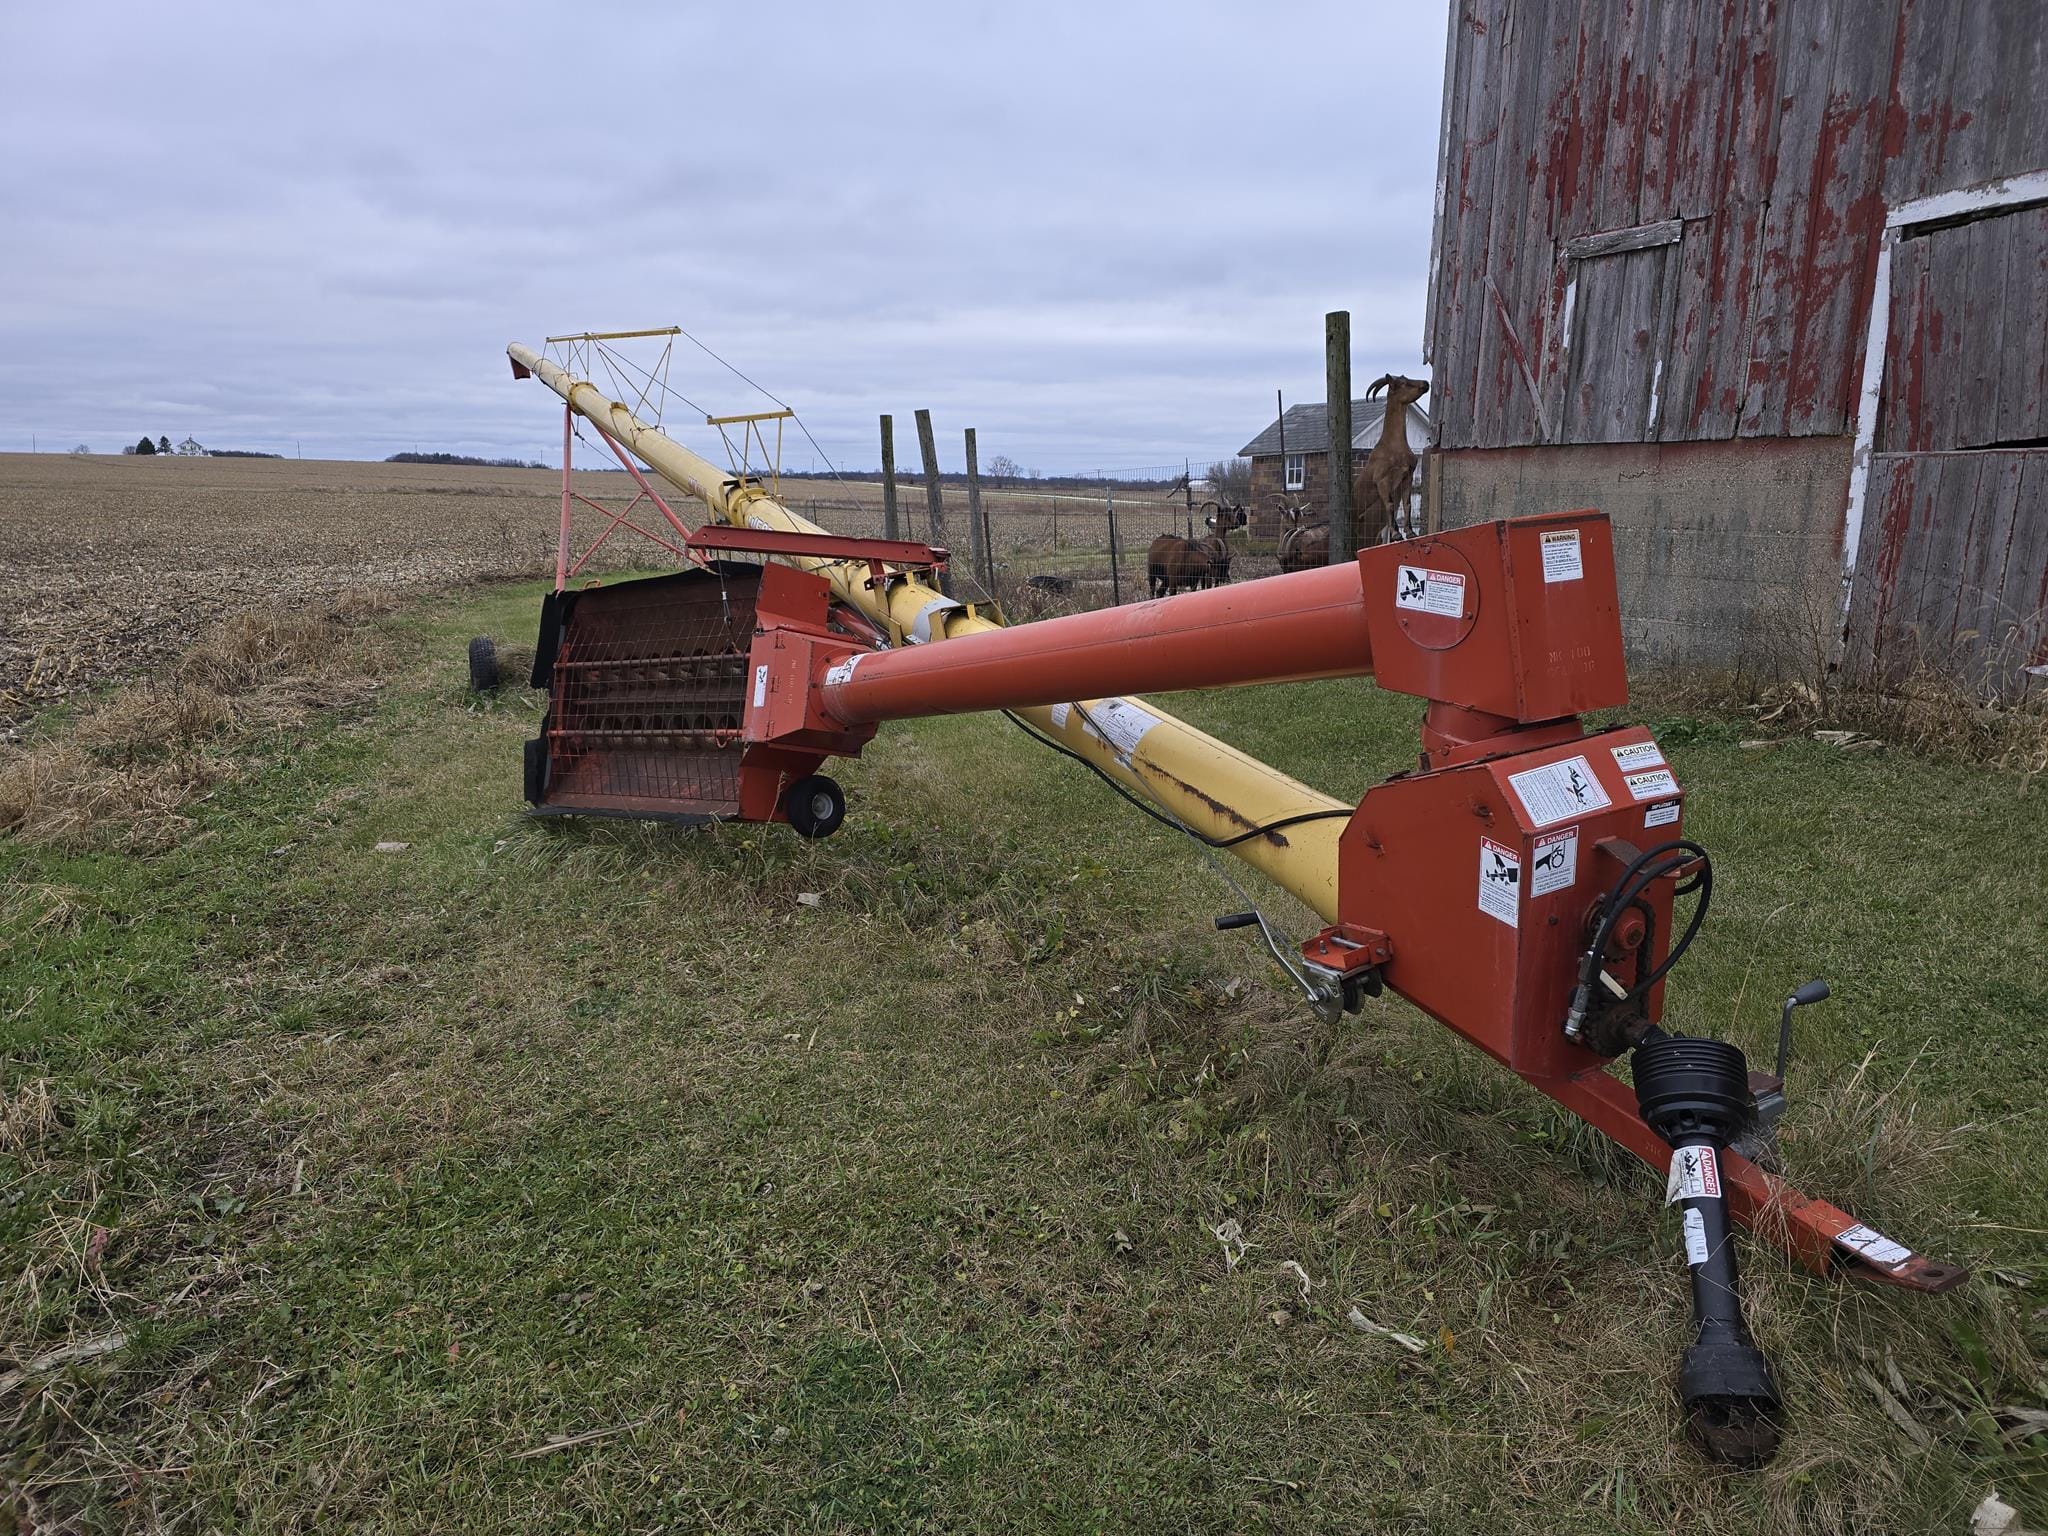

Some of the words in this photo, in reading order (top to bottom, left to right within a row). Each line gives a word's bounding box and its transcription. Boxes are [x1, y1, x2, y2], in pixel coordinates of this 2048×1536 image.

[1551, 533, 1576, 542] WARNING
[1436, 574, 1462, 586] DANGER
[1623, 744, 1656, 756] CAUTION
[1636, 773, 1670, 785] CAUTION
[1547, 831, 1574, 844] DANGER
[1492, 845, 1518, 861] DANGER
[1702, 1159, 1717, 1195] DANGER
